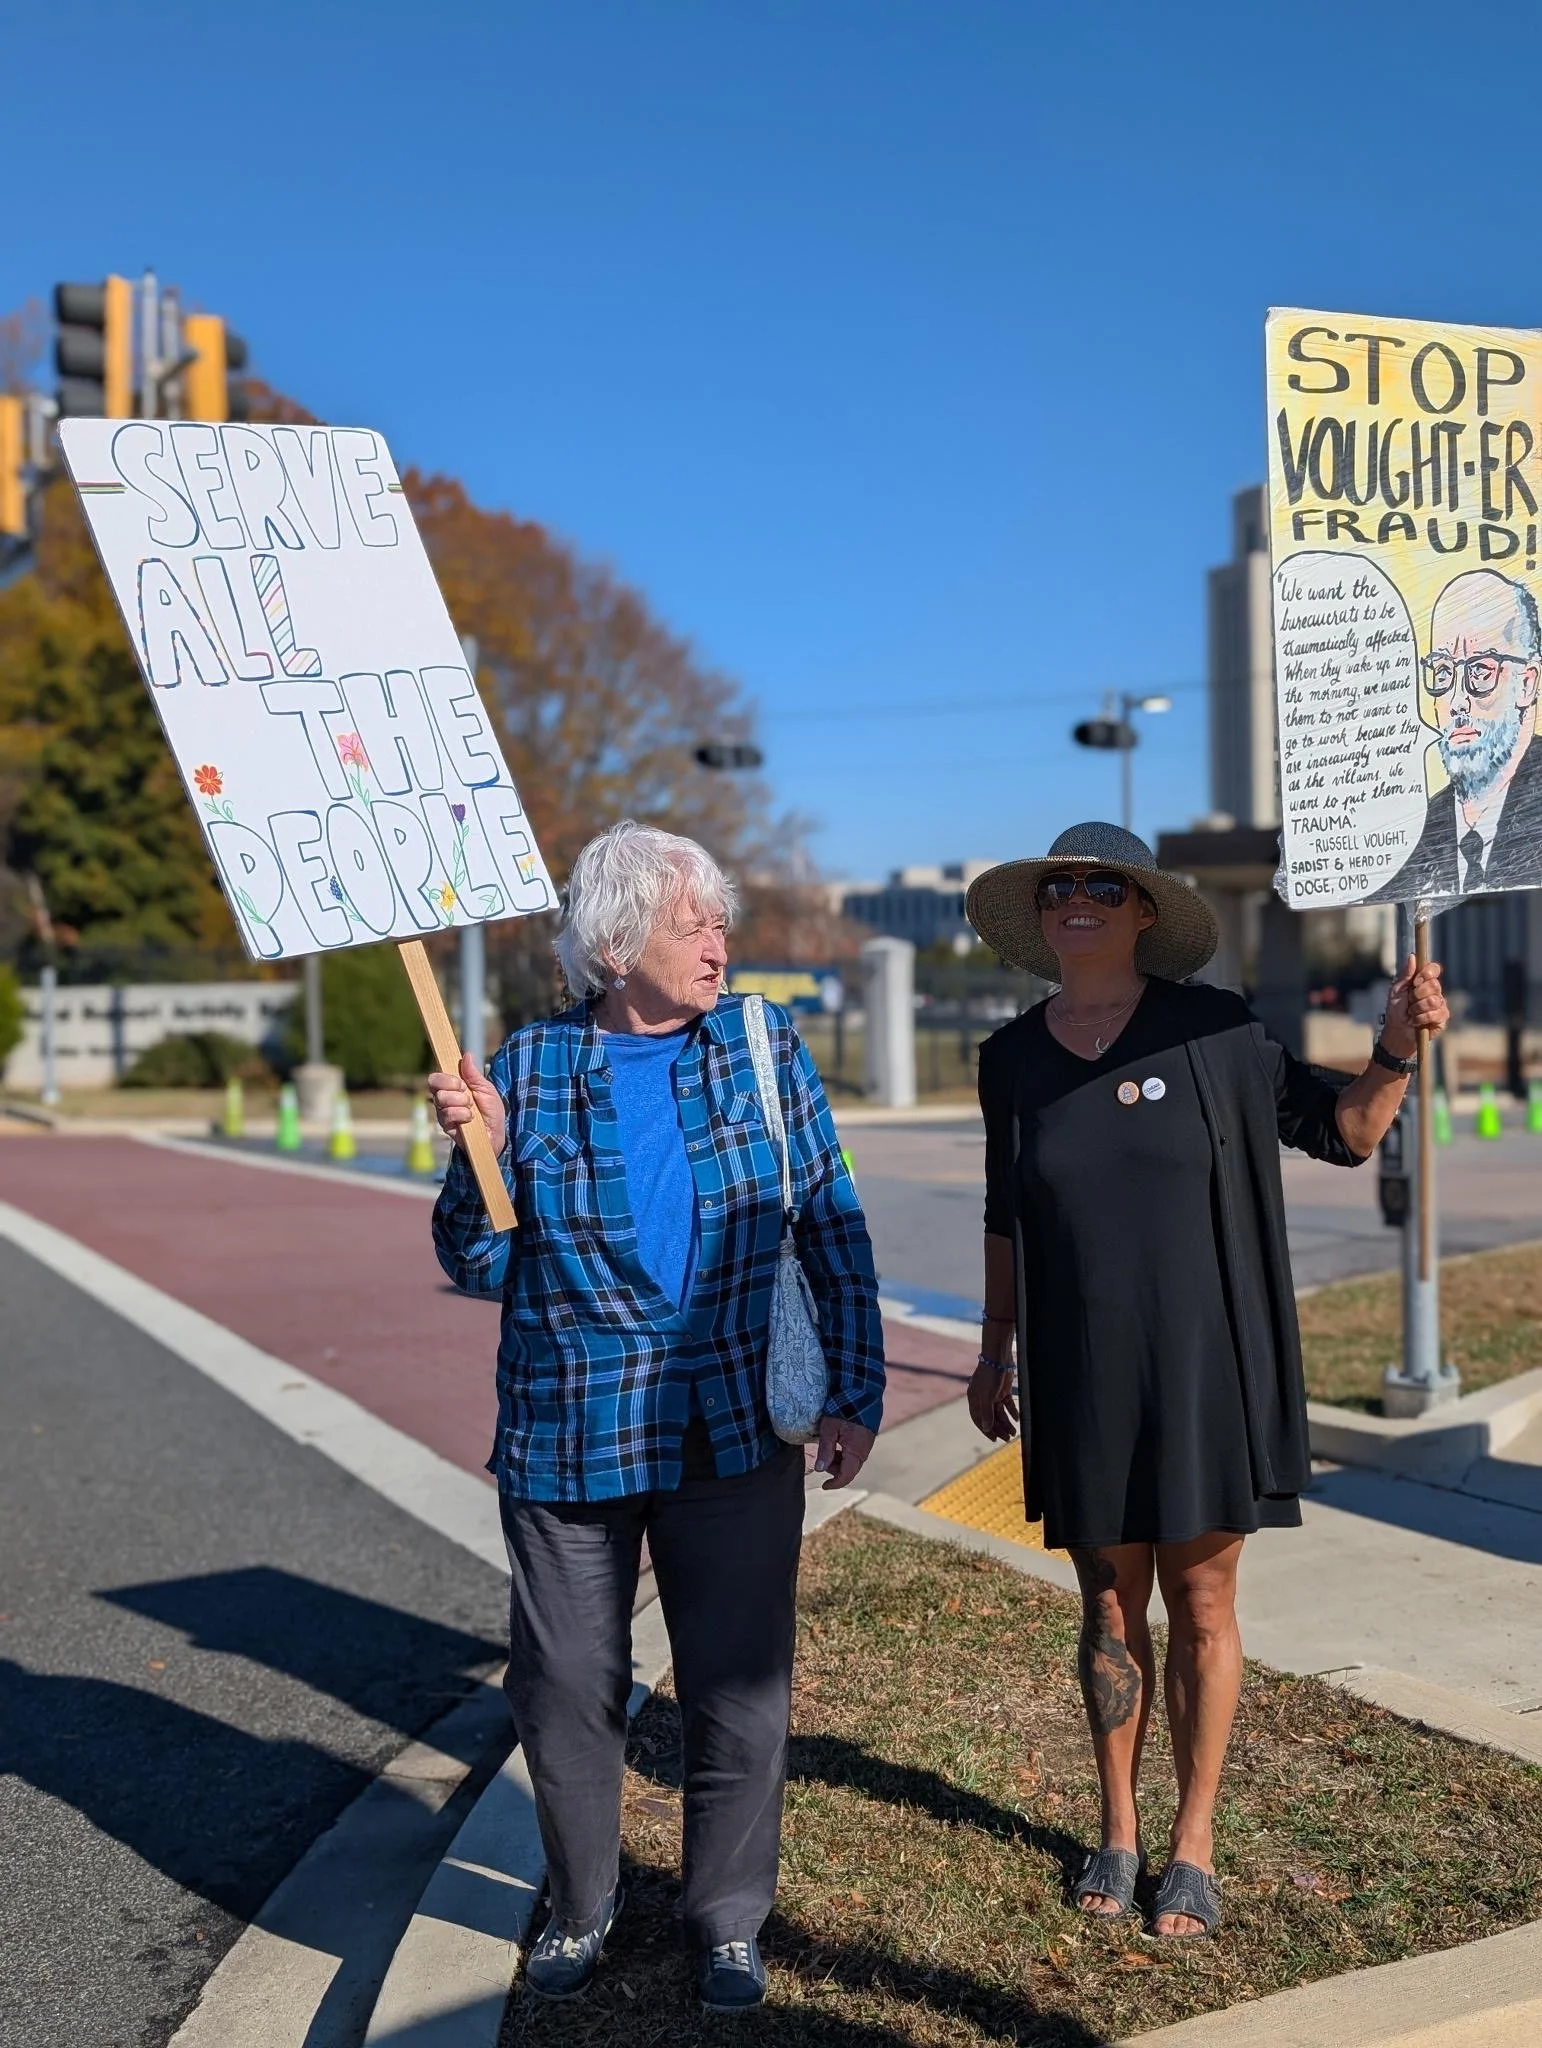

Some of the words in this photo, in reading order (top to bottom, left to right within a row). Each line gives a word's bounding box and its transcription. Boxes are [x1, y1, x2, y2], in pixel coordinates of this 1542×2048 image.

[1287, 326, 1526, 417] STOP
[1276, 407, 1540, 523] VOUGHT-ER
[112, 424, 399, 550] SERVE
[1292, 508, 1537, 571] FRAUD!
[1308, 579, 1346, 601] want
[1353, 574, 1380, 598] the
[137, 554, 322, 687] ALL
[1280, 605, 1359, 632] bureaucrats
[1363, 604, 1378, 621] to
[1379, 602, 1396, 620] be
[1282, 629, 1359, 657] traumatically
[1284, 660, 1317, 681] When
[1320, 658, 1342, 686] they
[1346, 655, 1373, 674] wake
[1376, 659, 1390, 676] up
[1395, 650, 1411, 668] in
[1284, 687, 1304, 704] the
[1309, 687, 1361, 707] morning,
[1364, 683, 1378, 695] we
[1381, 675, 1411, 693] want
[1284, 706, 1316, 727] them
[1319, 709, 1332, 724] to
[1336, 709, 1359, 723] not
[1363, 706, 1391, 718] want
[1396, 701, 1409, 713] to
[259, 666, 501, 800] THE
[1285, 740, 1298, 760] go
[1303, 736, 1315, 747] to
[1318, 728, 1349, 747] work
[1355, 725, 1396, 743] because
[1400, 718, 1421, 745] they
[1286, 764, 1301, 774] are
[1306, 745, 1371, 769] increasingly
[1376, 741, 1413, 757] viewed
[1288, 781, 1300, 792] as
[1304, 771, 1325, 789] the
[1332, 769, 1382, 787] villains.
[1289, 800, 1319, 812] want
[1323, 798, 1338, 810] to
[1342, 792, 1367, 811] put
[1371, 782, 1405, 800] them
[1408, 780, 1423, 794] in
[1364, 830, 1408, 848] VOUGHT,
[207, 785, 550, 959] PEOPLE
[1291, 858, 1330, 875] SADIST
[1334, 858, 1344, 871] &
[1349, 857, 1374, 869] HEAD
[1377, 854, 1392, 866] OF
[1295, 878, 1335, 897] DOGE,
[1338, 874, 1369, 892] OMB
